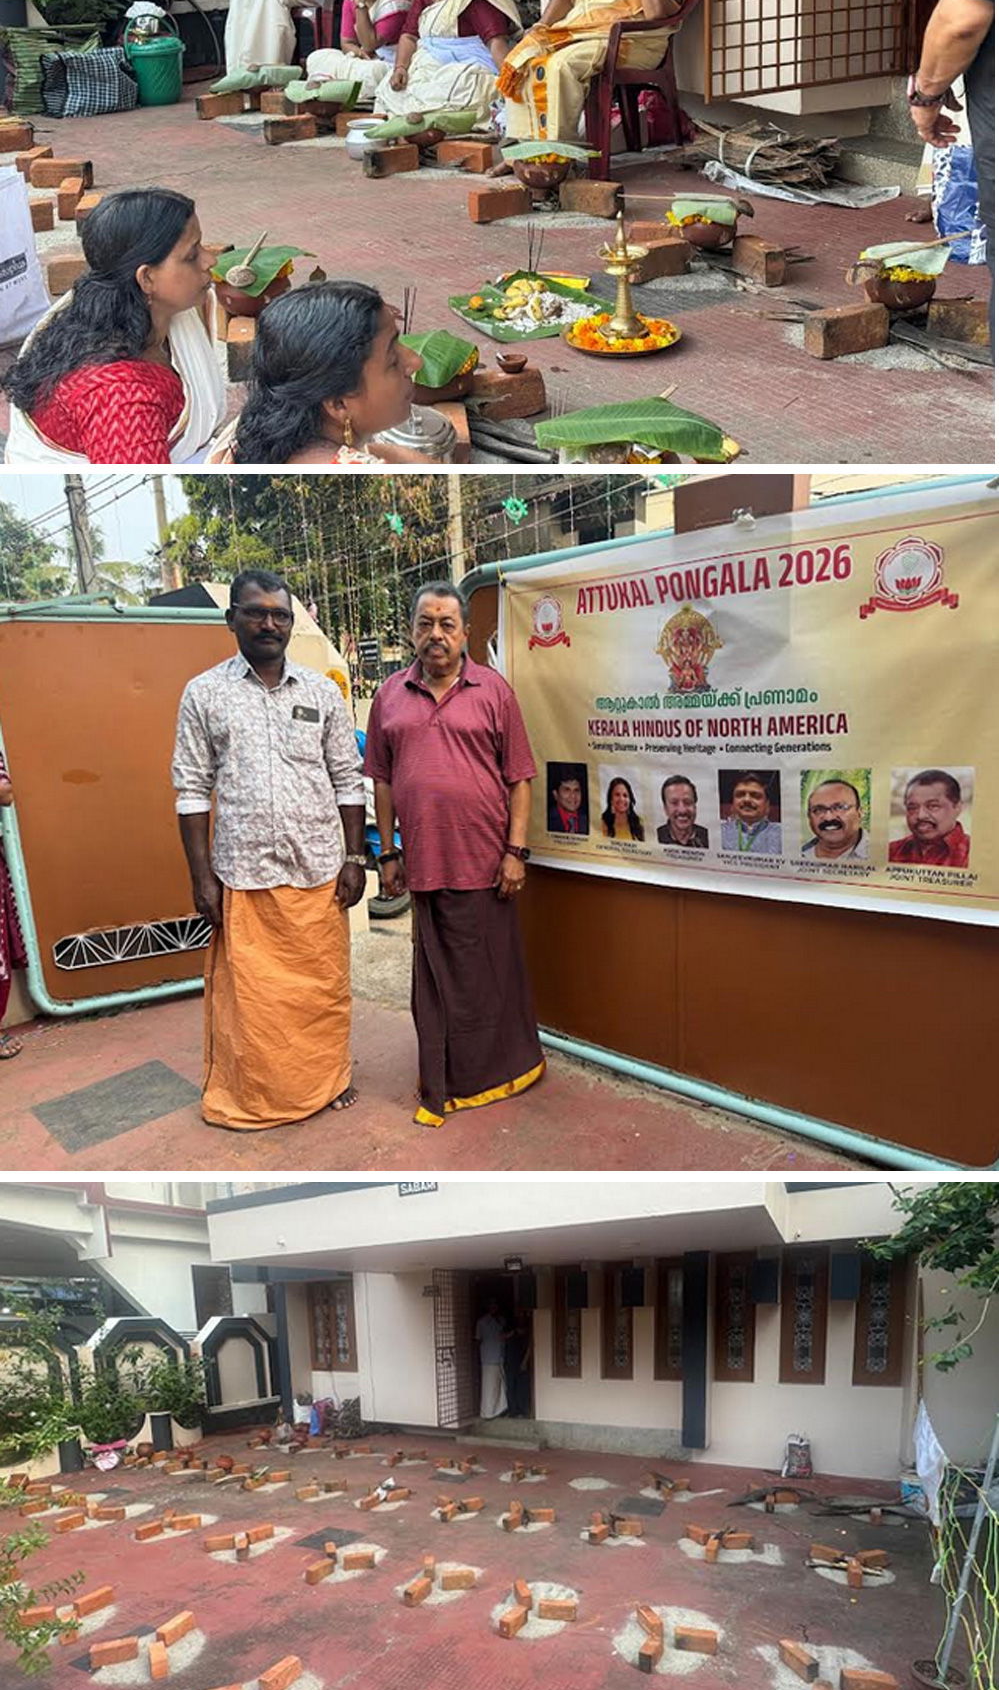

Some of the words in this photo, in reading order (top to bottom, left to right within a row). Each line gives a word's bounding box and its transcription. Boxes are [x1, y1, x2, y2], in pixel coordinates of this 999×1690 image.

[576, 578, 654, 615] ATTUKAL
[656, 557, 770, 604] PONGALA
[778, 544, 851, 588] 2026
[744, 687, 818, 710] പ്രണാമം
[587, 719, 630, 737] KERALA
[633, 719, 681, 738] HINDUS
[685, 719, 703, 738] OF
[708, 716, 762, 738] NORTH
[767, 712, 848, 737] AMERICA
[645, 743, 683, 755] Preserving
[683, 743, 716, 755] Heritage
[725, 742, 774, 755] Connecting
[774, 741, 832, 753] Generations
[885, 866, 945, 878] APPUKUTTAN
[947, 871, 978, 881] PILLAI
[889, 873, 915, 882] JOINT
[918, 876, 974, 888] TREASURER
